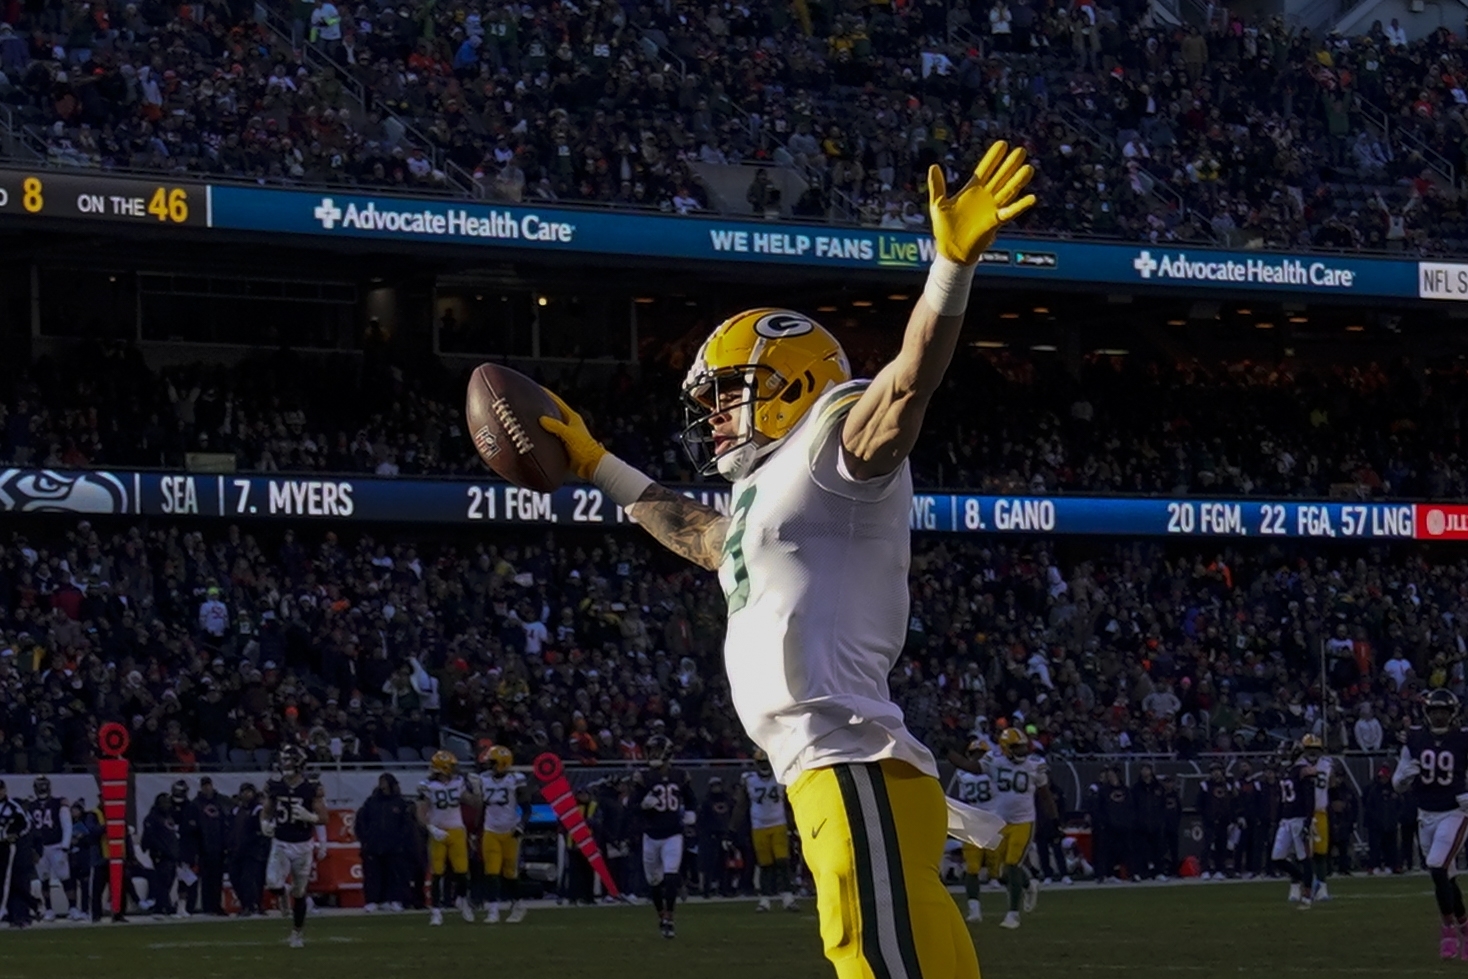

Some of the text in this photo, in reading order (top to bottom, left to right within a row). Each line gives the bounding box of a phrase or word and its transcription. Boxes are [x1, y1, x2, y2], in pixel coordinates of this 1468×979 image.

[23, 176, 44, 213] 8
[77, 193, 105, 214] ON
[109, 196, 146, 217] THE
[148, 186, 189, 223] 46
[709, 229, 749, 252] WE
[753, 232, 812, 256] HELP
[814, 236, 874, 260] FANS
[1423, 272, 1452, 293] NFL
[160, 475, 198, 514] SEA
[233, 478, 354, 517] 7. MYERS
[467, 485, 496, 519] 21
[504, 486, 558, 523] FGM,
[572, 488, 603, 522] 22
[965, 498, 1055, 531] 8. GANO
[1167, 503, 1411, 538] 20 FGM, 22 FGA, 57 LNG
[996, 768, 1030, 794] 50
[1419, 749, 1455, 787] 99
[434, 788, 460, 811] 85
[485, 788, 509, 806] 73
[652, 783, 680, 813] 36
[754, 786, 780, 804] 74
[964, 780, 991, 803] 28
